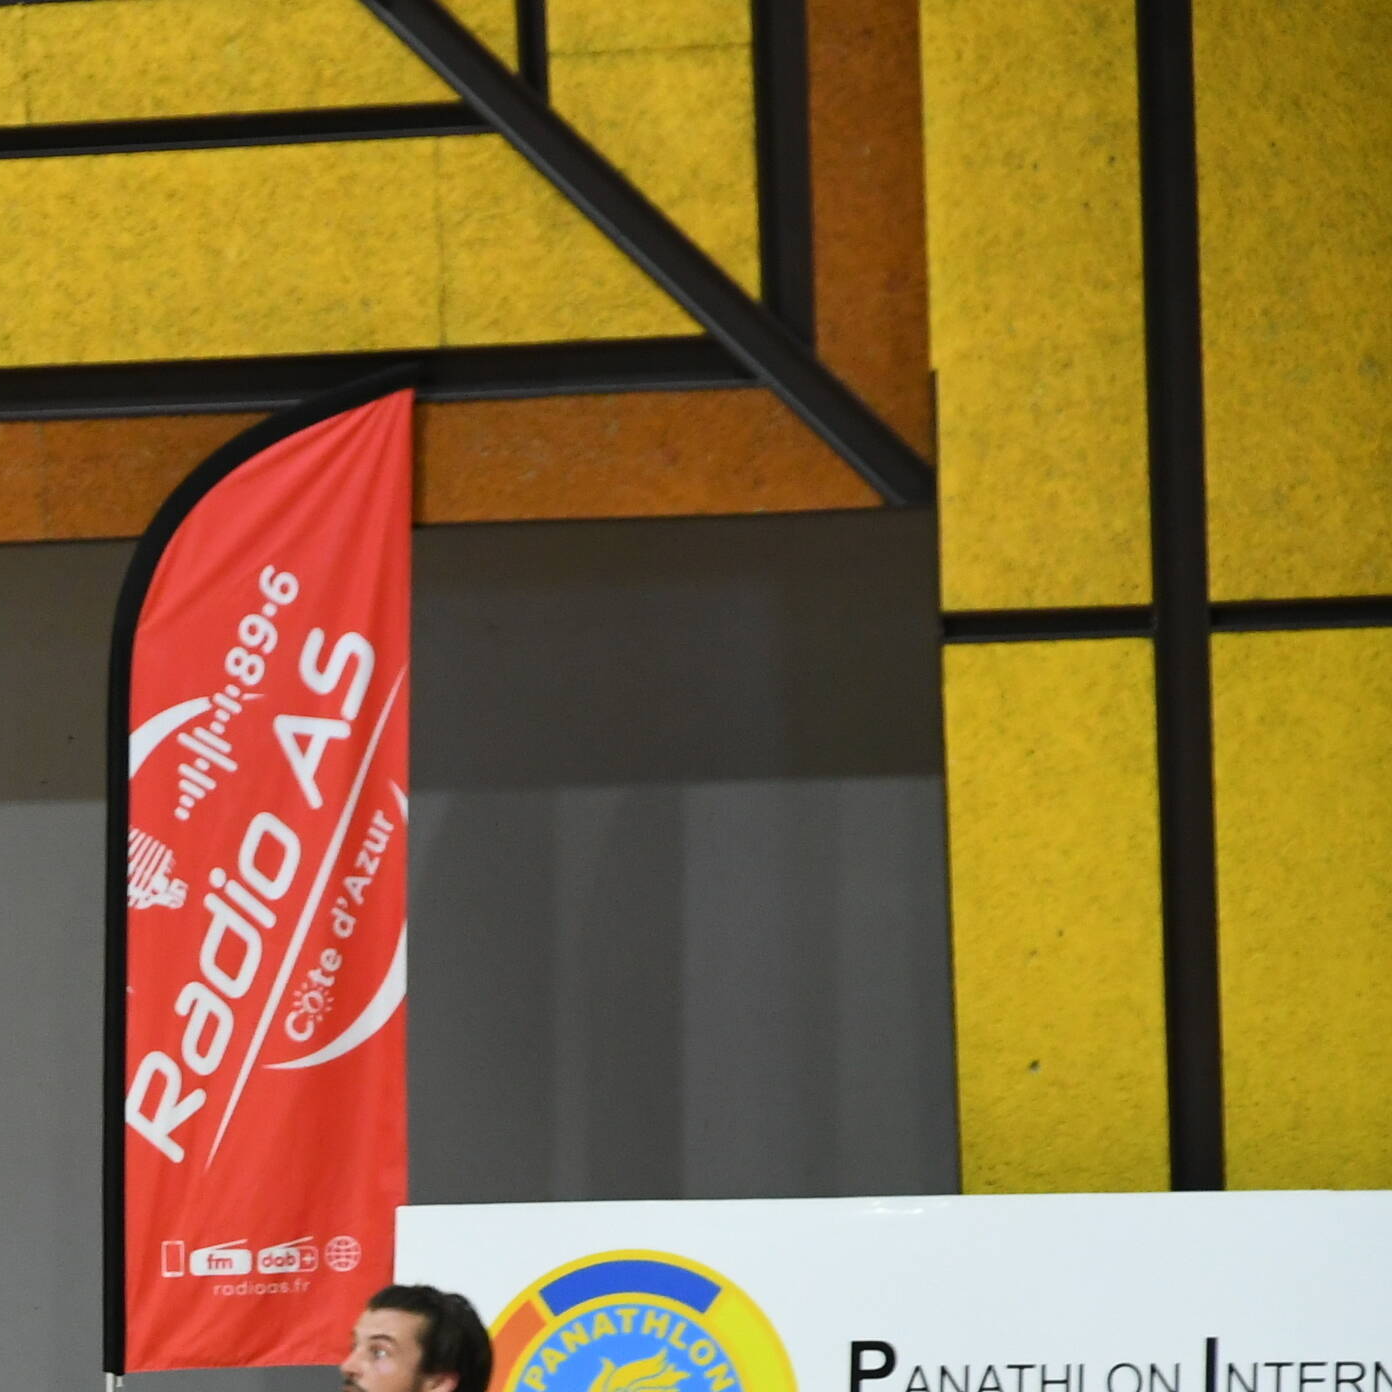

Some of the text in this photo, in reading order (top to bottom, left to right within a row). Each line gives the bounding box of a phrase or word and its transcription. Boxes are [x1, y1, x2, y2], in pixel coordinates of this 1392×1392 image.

[125, 627, 375, 1163] Radio AS
[330, 809, 394, 938] d'Azur
[206, 1254, 233, 1270] fm
[522, 1308, 736, 1392] PANATHLON
